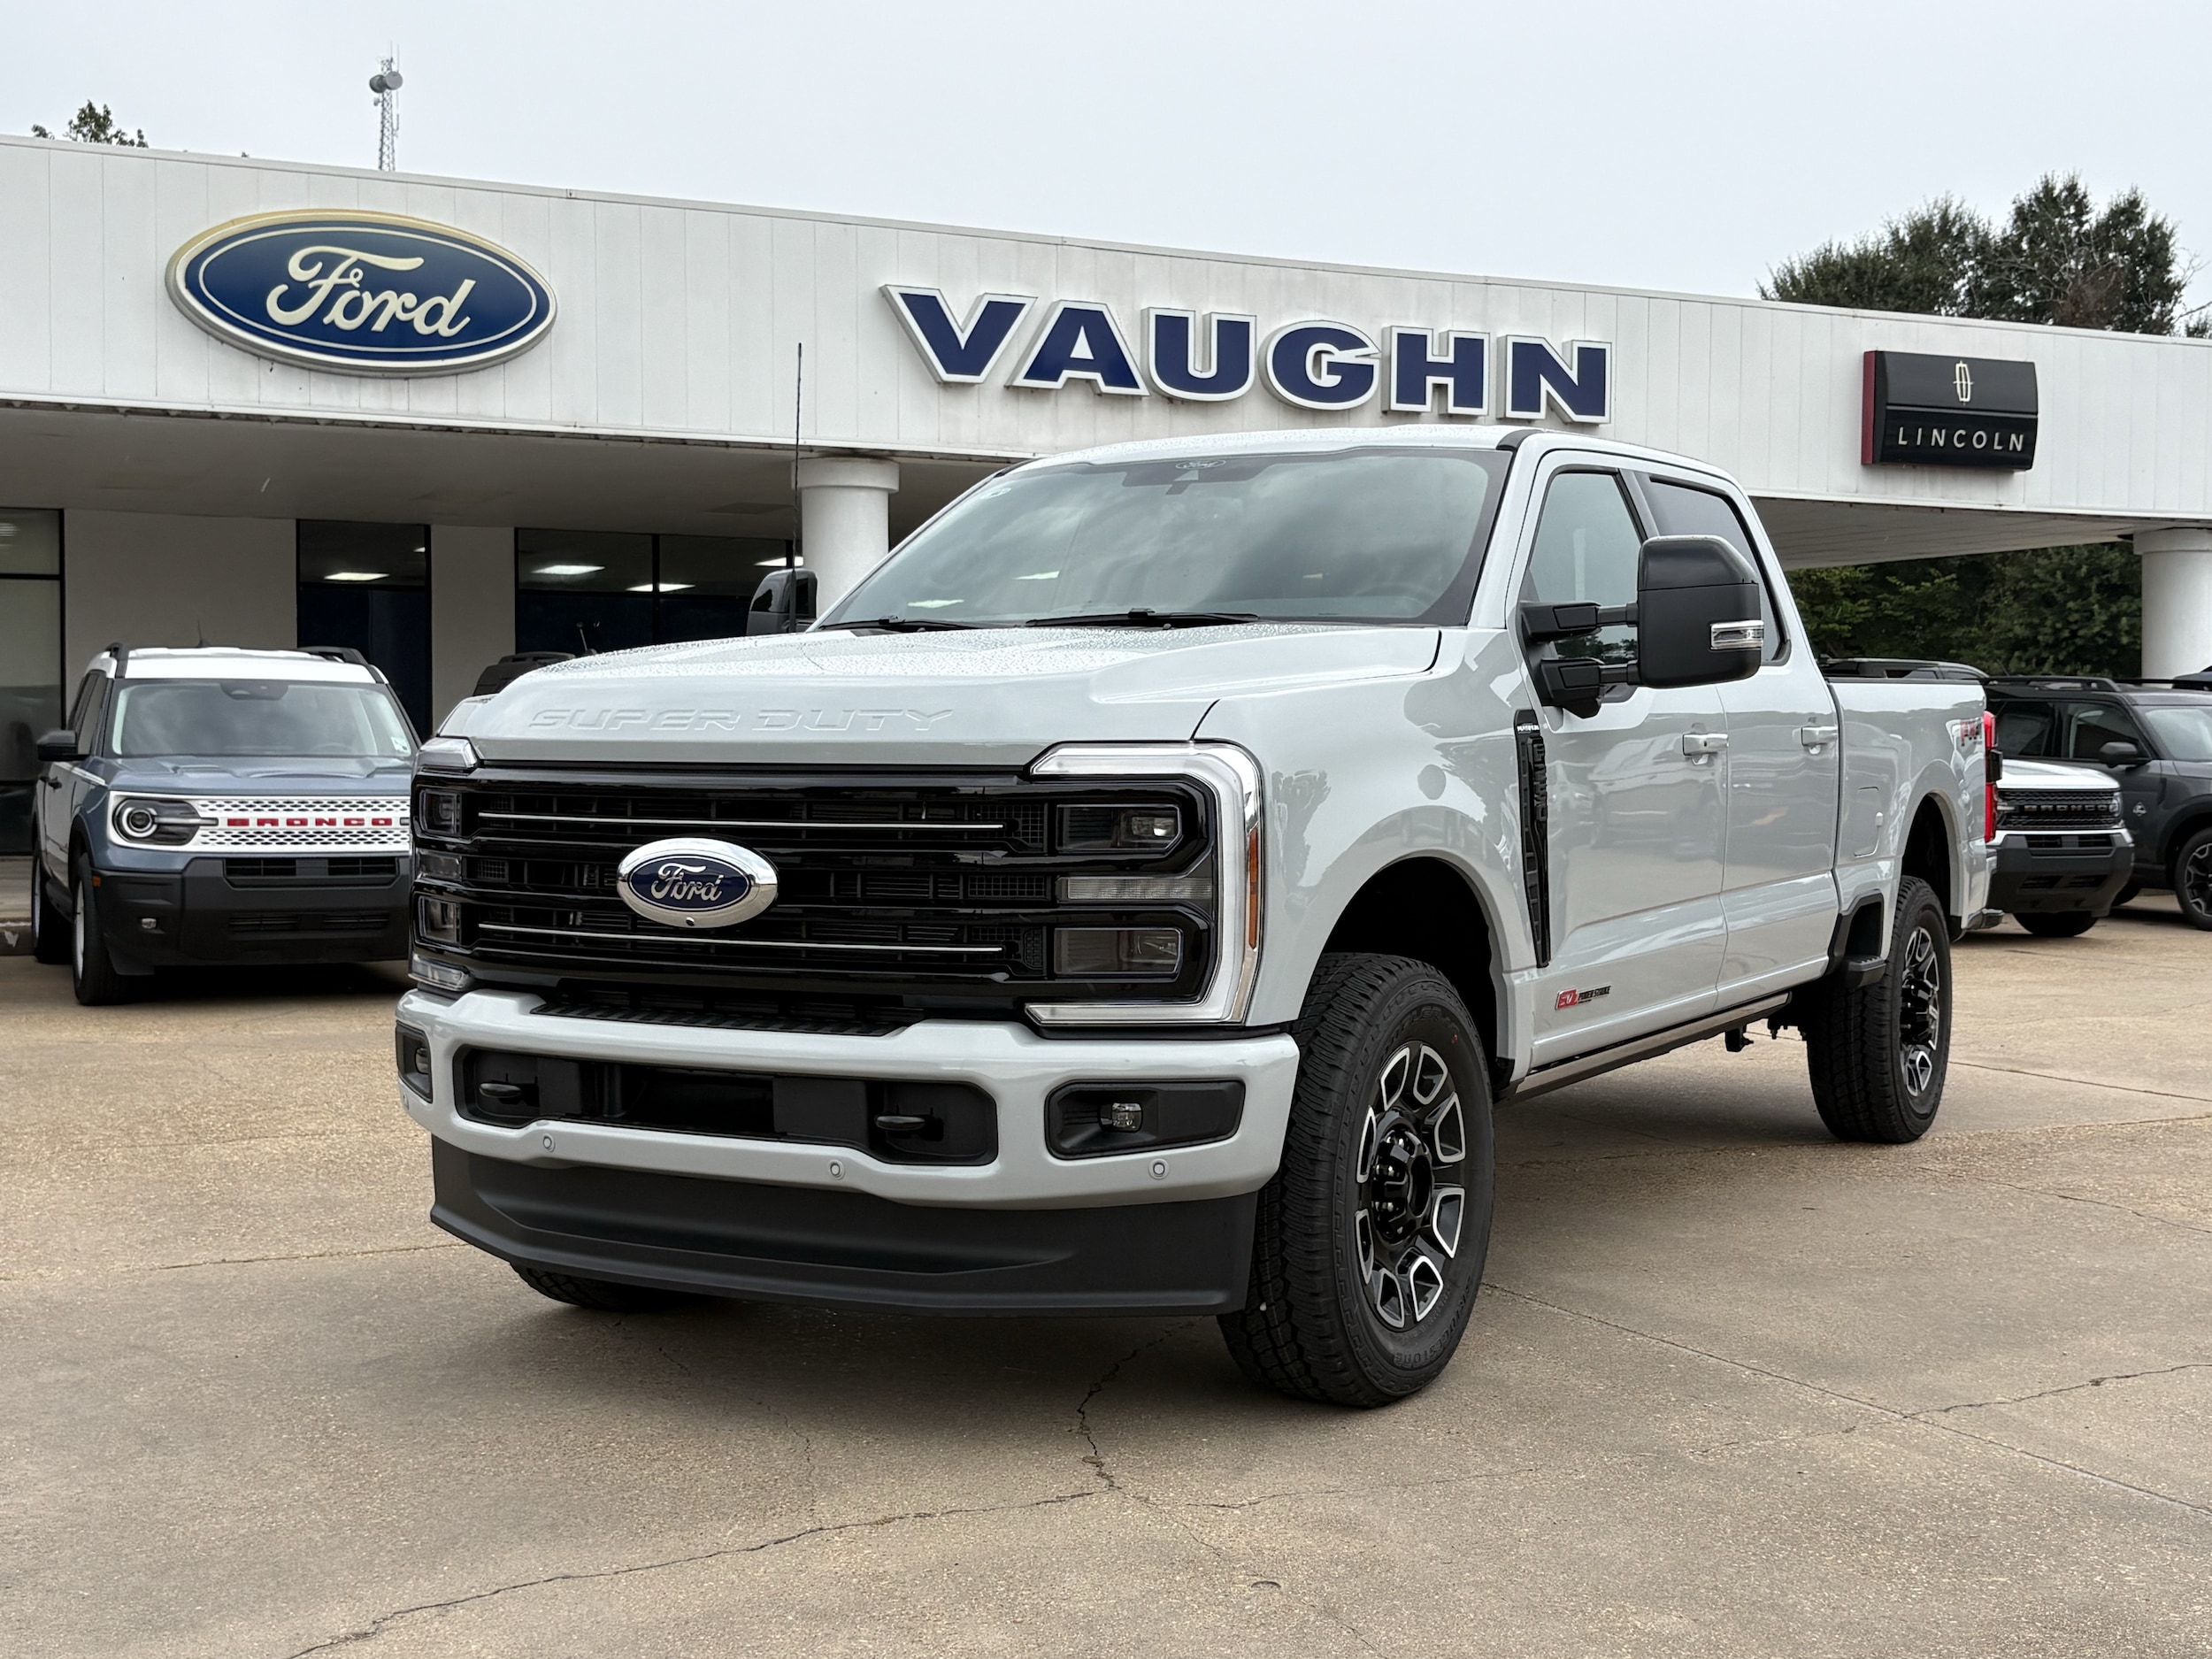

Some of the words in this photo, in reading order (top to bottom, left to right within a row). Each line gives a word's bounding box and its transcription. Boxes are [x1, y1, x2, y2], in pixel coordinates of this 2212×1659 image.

[266, 245, 477, 338] Ford
[880, 284, 1612, 426] VAUGHN
[1898, 426, 2024, 452] LINCOLN
[528, 708, 741, 732] SUPER
[751, 708, 955, 733] DUTY
[227, 818, 393, 827] BRONCO
[650, 862, 725, 902] Ford
